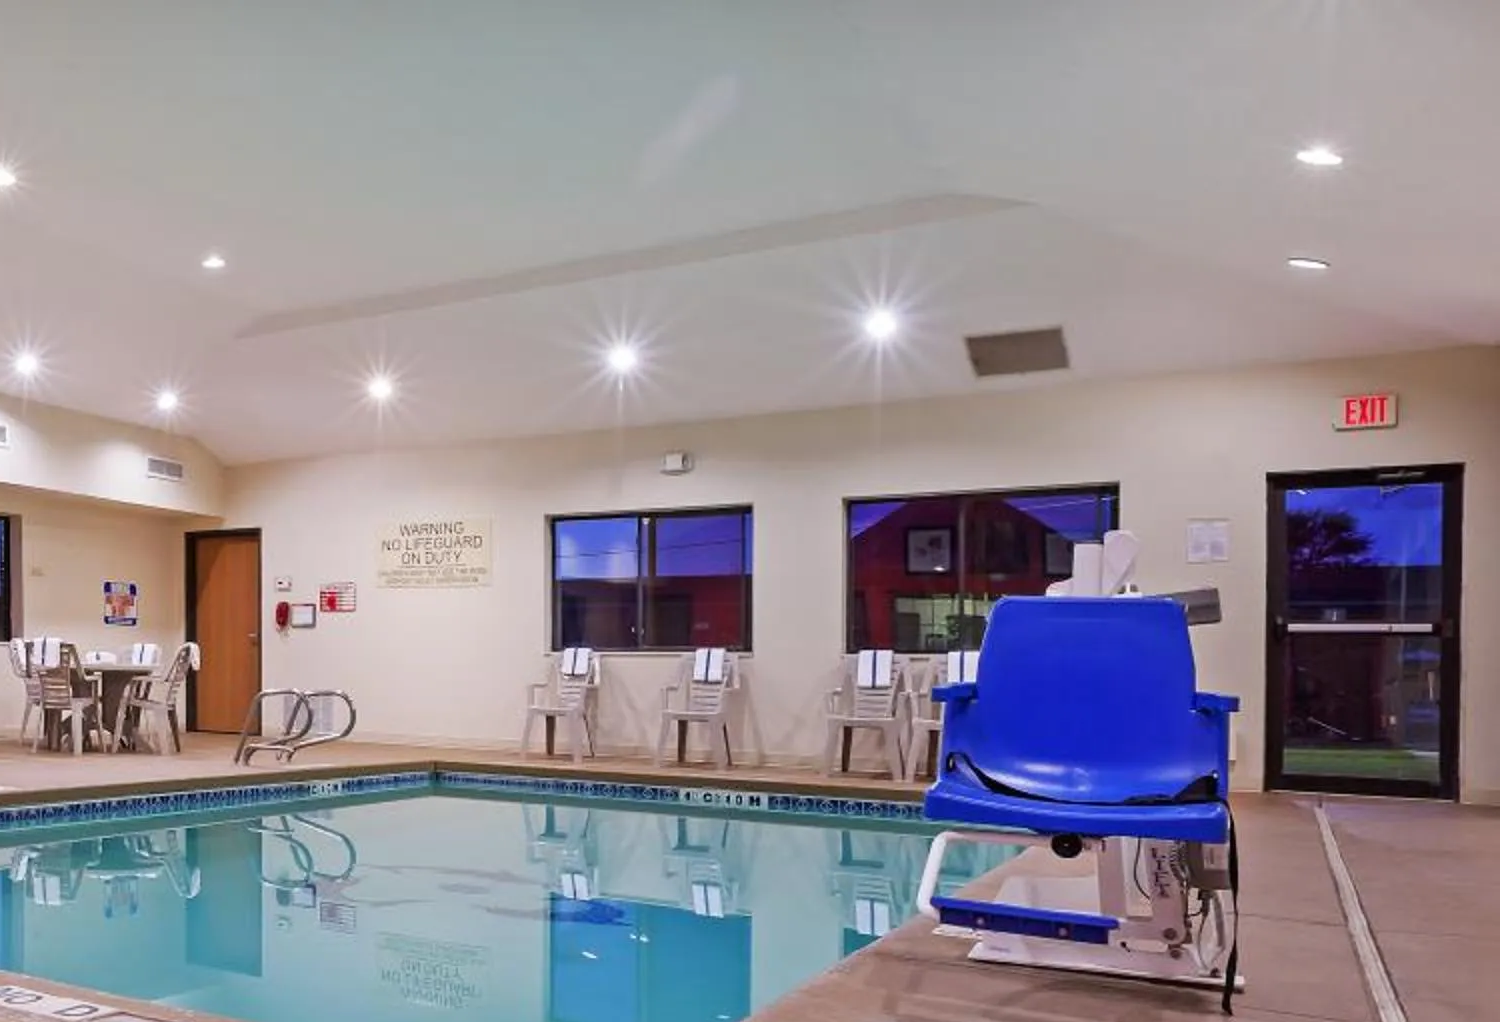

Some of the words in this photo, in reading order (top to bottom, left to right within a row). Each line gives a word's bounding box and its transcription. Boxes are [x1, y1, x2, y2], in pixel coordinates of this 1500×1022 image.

[1345, 397, 1388, 425] EXIT
[400, 520, 465, 537] WARNING
[381, 538, 401, 552] NO
[405, 535, 483, 552] LIFEGUARD
[401, 551, 421, 565] ON
[425, 550, 463, 565] DUTY
